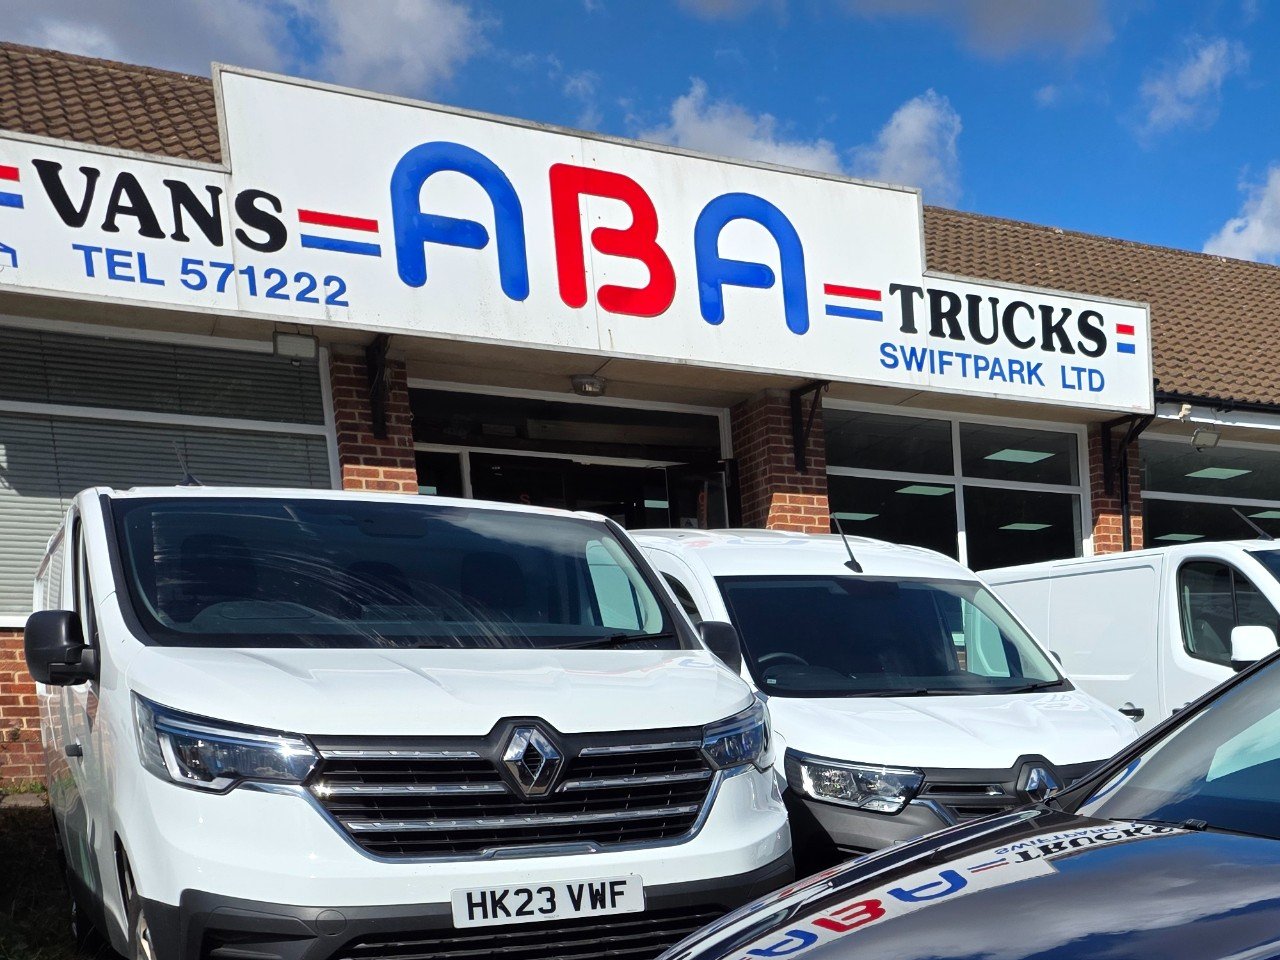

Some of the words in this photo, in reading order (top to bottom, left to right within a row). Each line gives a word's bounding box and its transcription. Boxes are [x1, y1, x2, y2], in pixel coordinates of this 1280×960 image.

[32, 158, 288, 253] VANS
[390, 141, 809, 337] ABA
[72, 243, 165, 287] TEL
[180, 259, 349, 307] 571222
[889, 283, 1107, 358] TRUCKS
[879, 342, 1045, 387] SWIFTPARK
[1061, 364, 1106, 392] LTD
[466, 886, 557, 920] HK23
[566, 880, 627, 912] VWF
